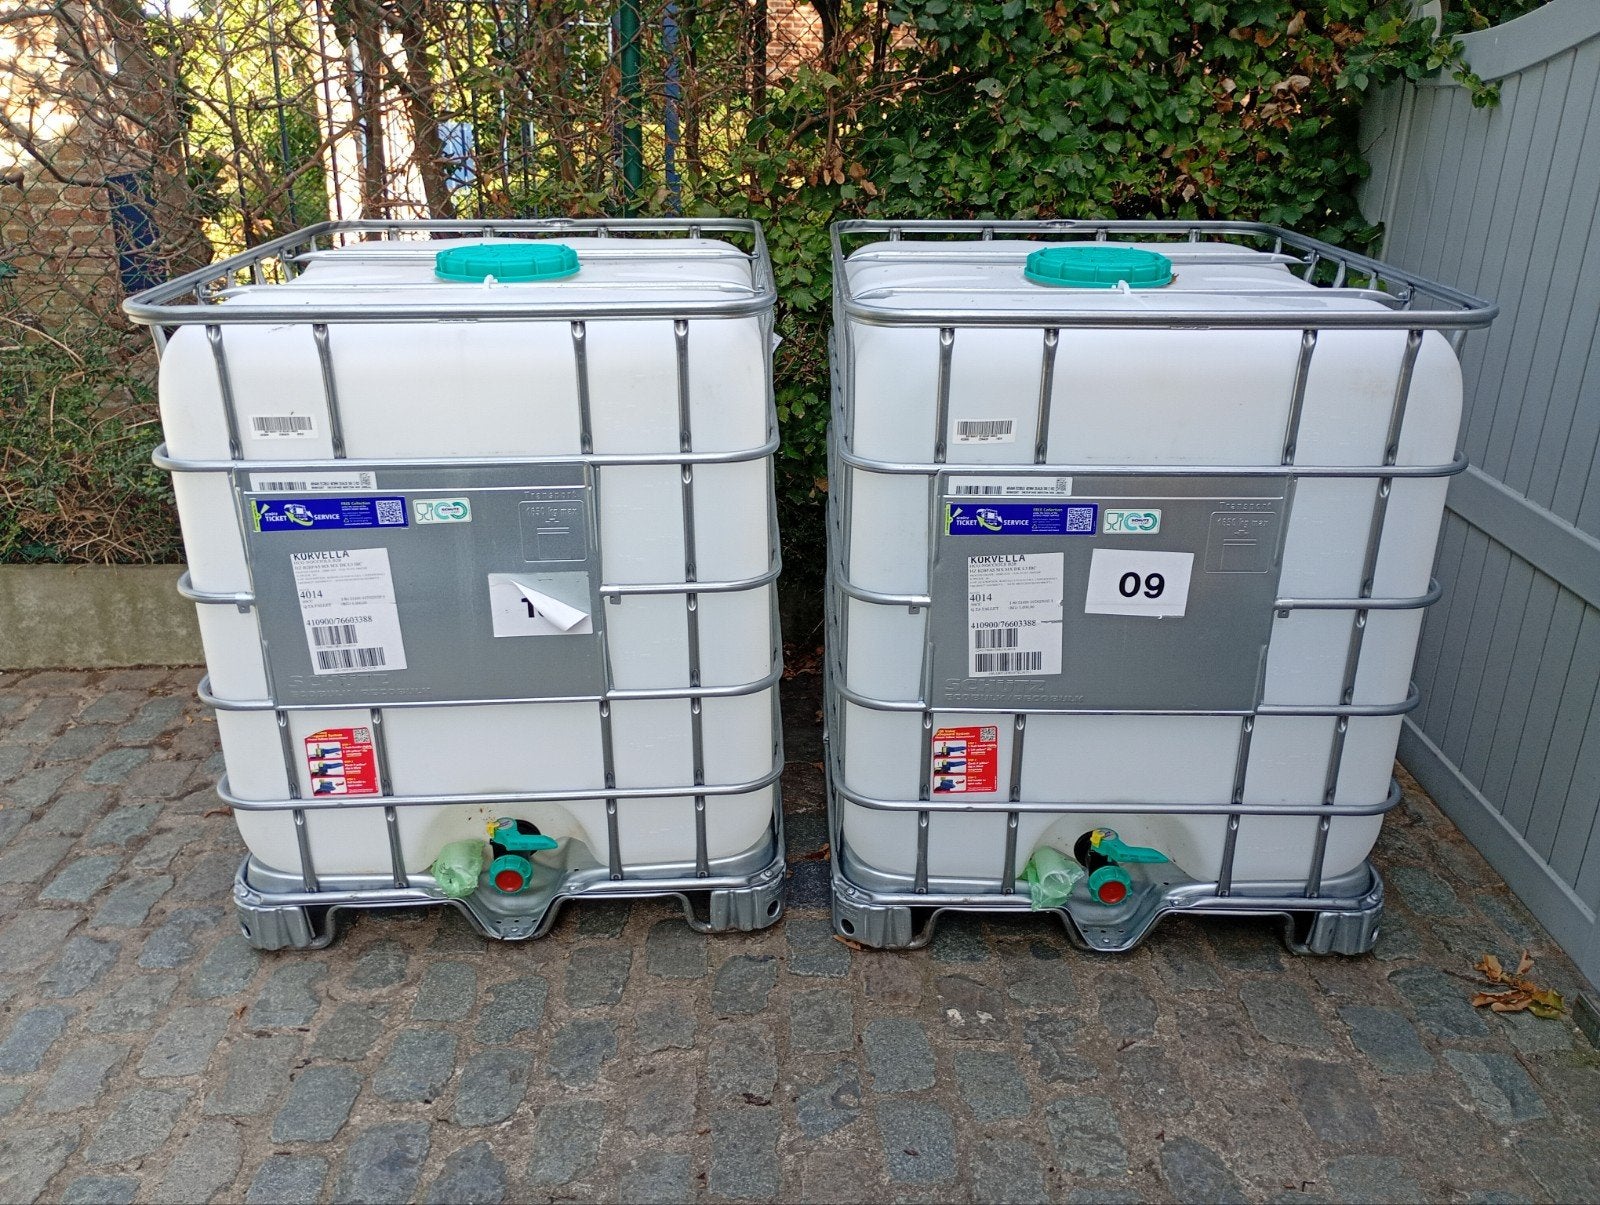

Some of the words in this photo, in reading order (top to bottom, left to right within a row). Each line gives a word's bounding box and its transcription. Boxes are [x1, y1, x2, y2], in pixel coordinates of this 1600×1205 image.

[314, 513, 341, 521] SERVICE
[1118, 571, 1166, 599] 09
[299, 589, 323, 600] 4014
[969, 593, 993, 602] 4014
